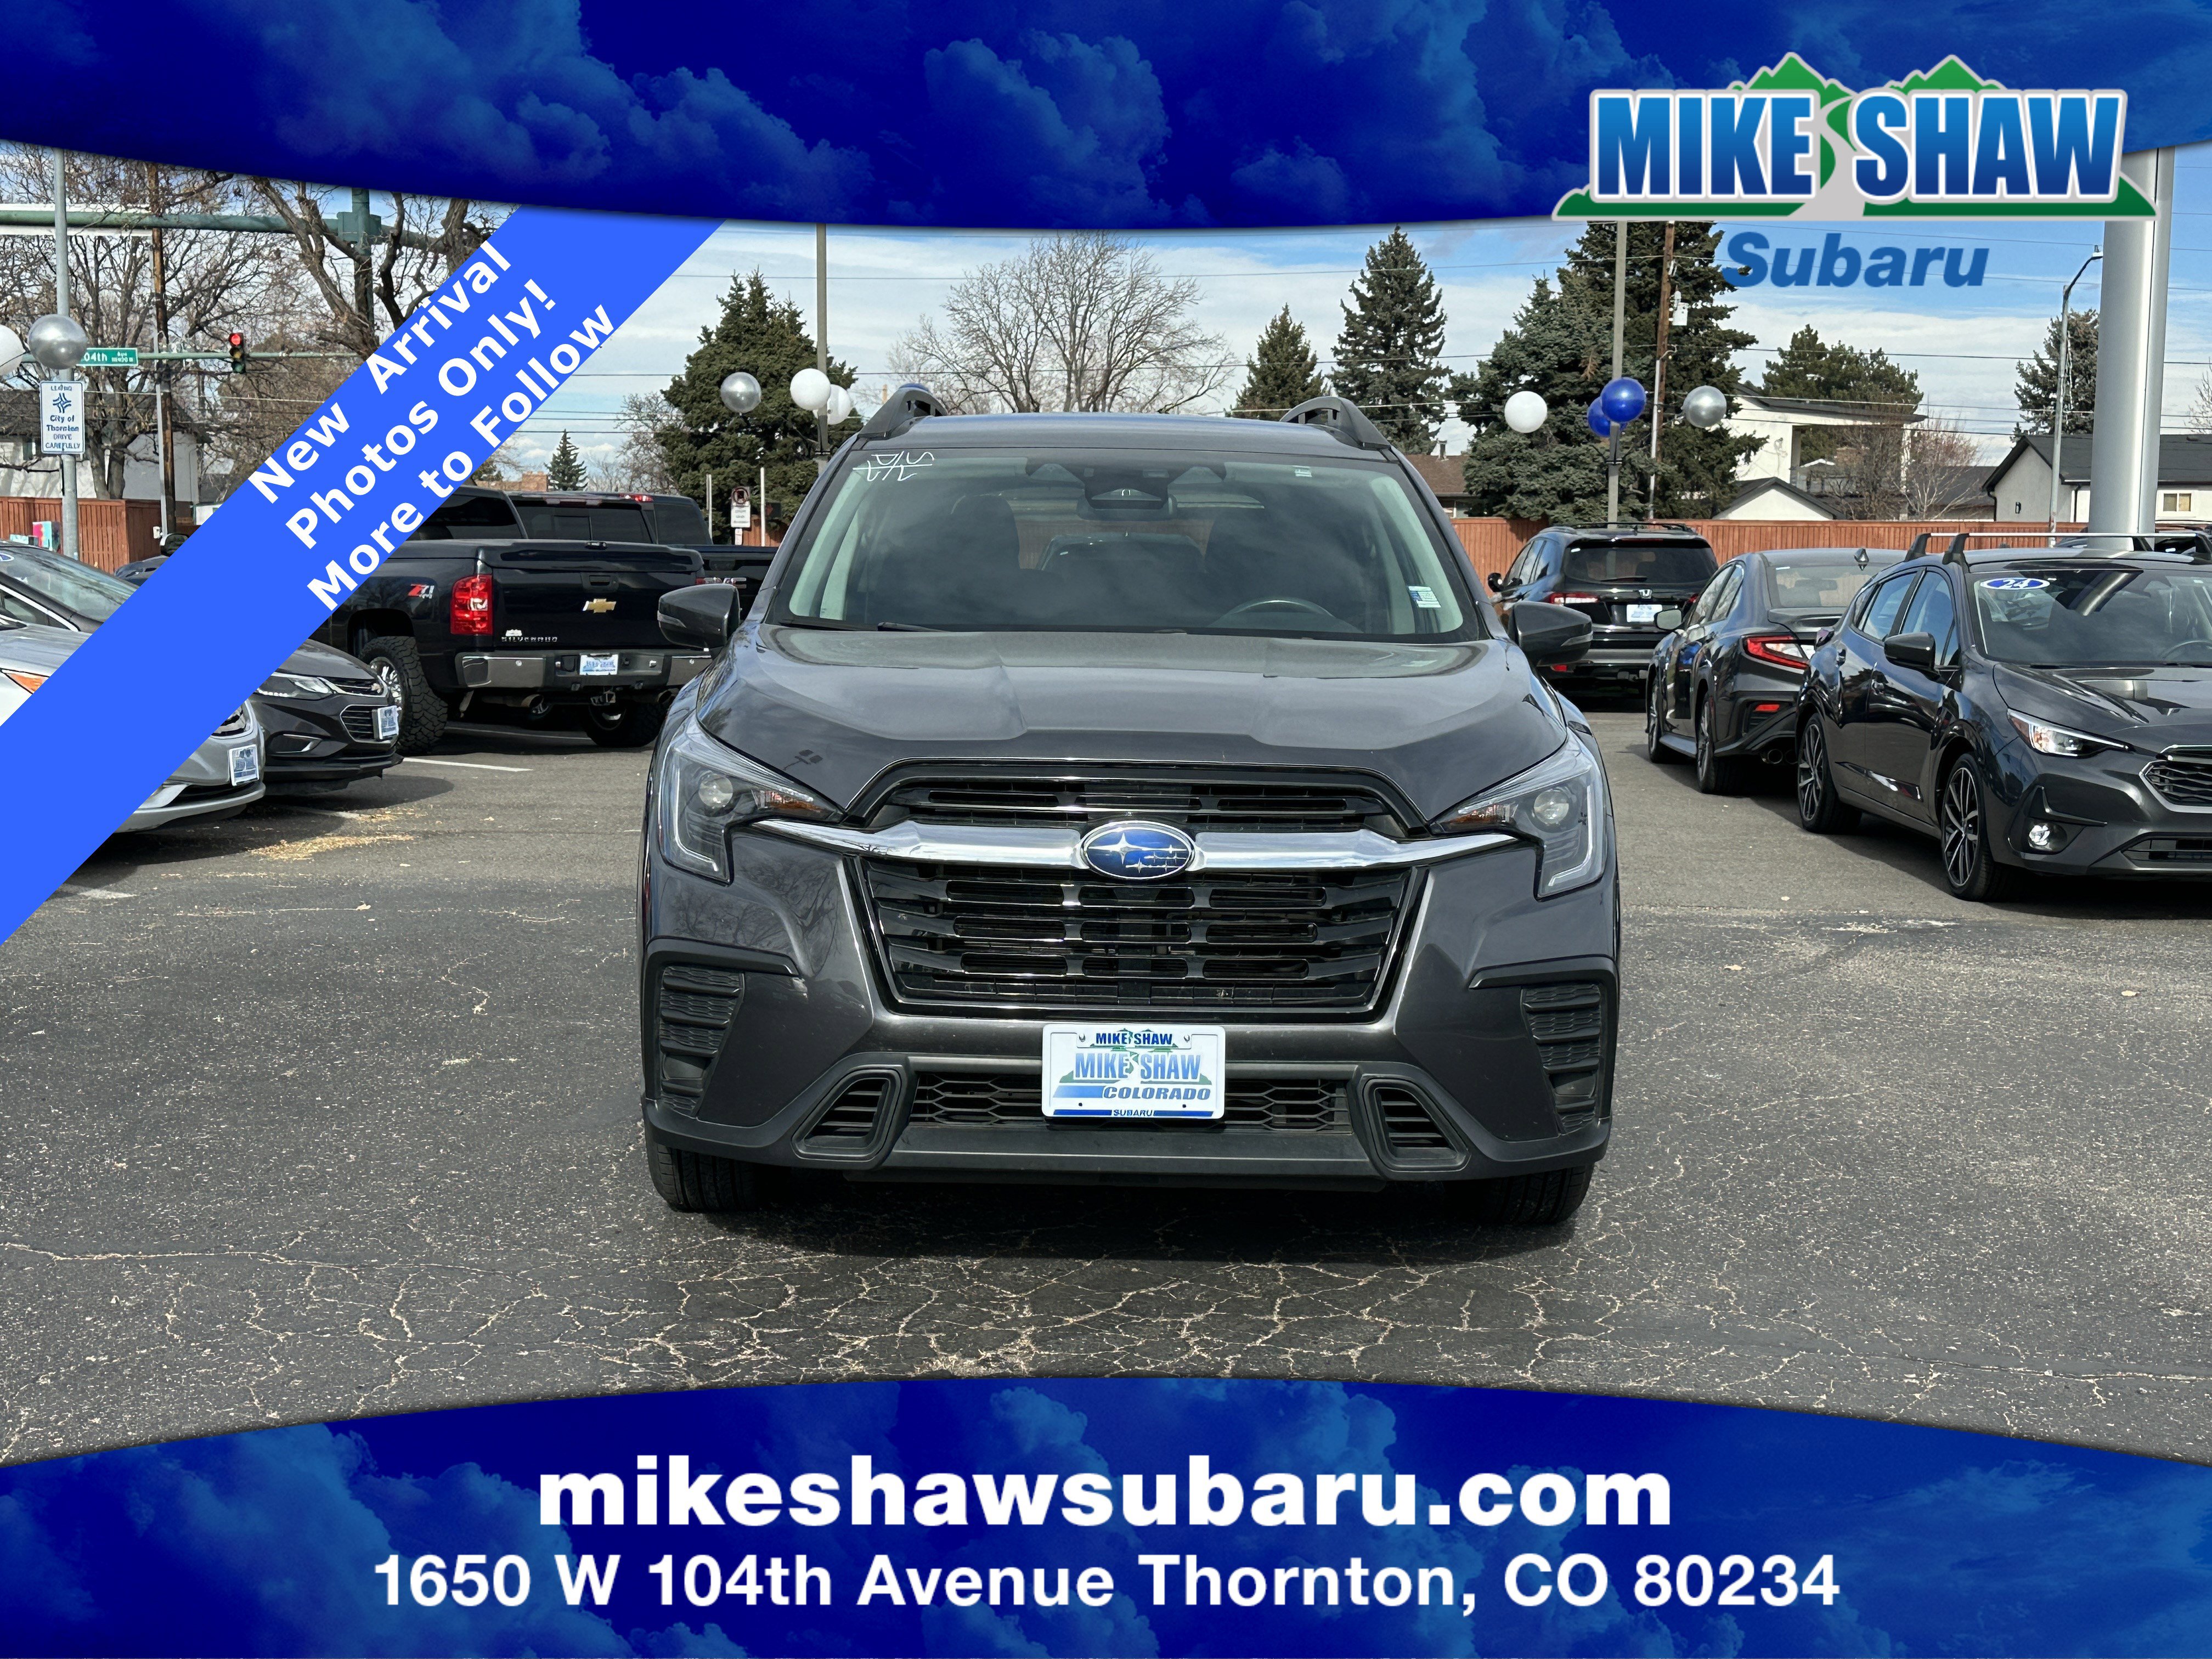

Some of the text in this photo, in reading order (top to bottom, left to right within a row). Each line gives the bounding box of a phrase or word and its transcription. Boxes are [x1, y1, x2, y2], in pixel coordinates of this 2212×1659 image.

[81, 352, 108, 362] 04th
[50, 415, 65, 423] City
[1096, 1032, 1173, 1045] MIKE SHAW
[1075, 1052, 1201, 1080] MIKE SHAW
[1103, 1086, 1211, 1101] COLORADO
[1113, 1109, 1154, 1117] SUBARU
